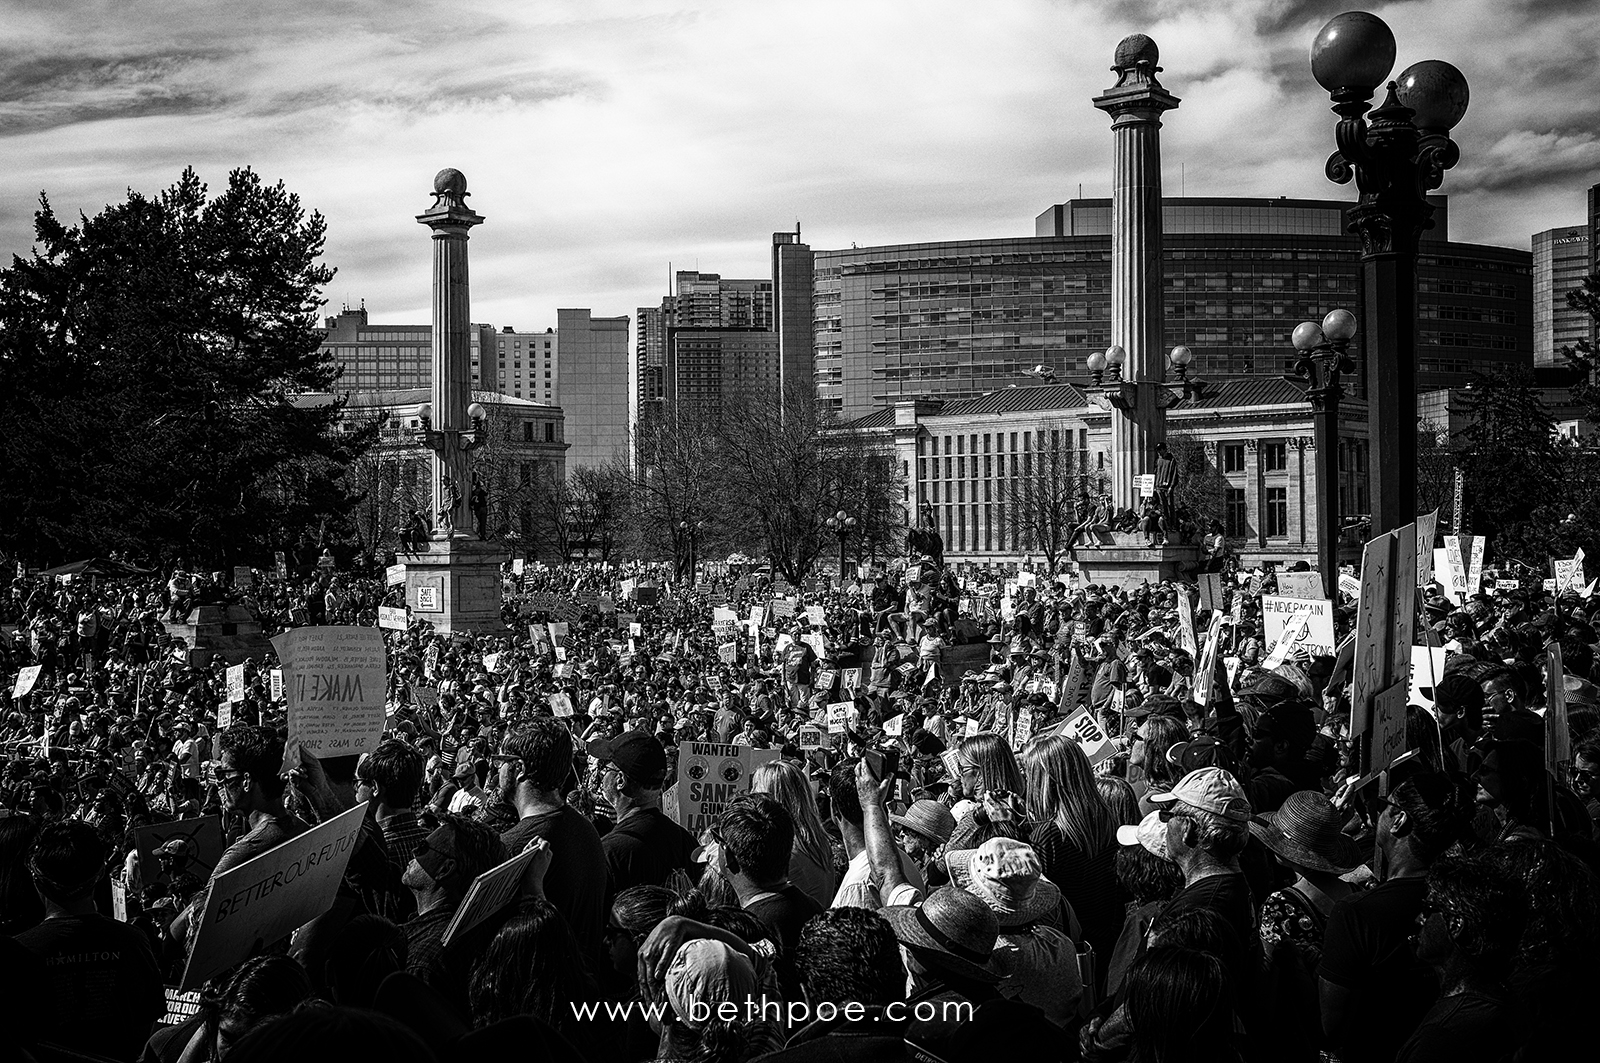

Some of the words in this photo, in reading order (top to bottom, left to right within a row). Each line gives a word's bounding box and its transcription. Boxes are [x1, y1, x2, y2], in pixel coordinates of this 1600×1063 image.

[1065, 686, 1077, 708] GAME
[1074, 715, 1104, 743] STOP
[691, 742, 740, 758] WANTED
[701, 802, 724, 815] GUN
[214, 871, 283, 924] BETTER
[284, 852, 316, 884] OUR
[316, 828, 359, 866] FUTUR
[165, 988, 201, 1003] MARCH
[166, 1000, 182, 1013] OR
